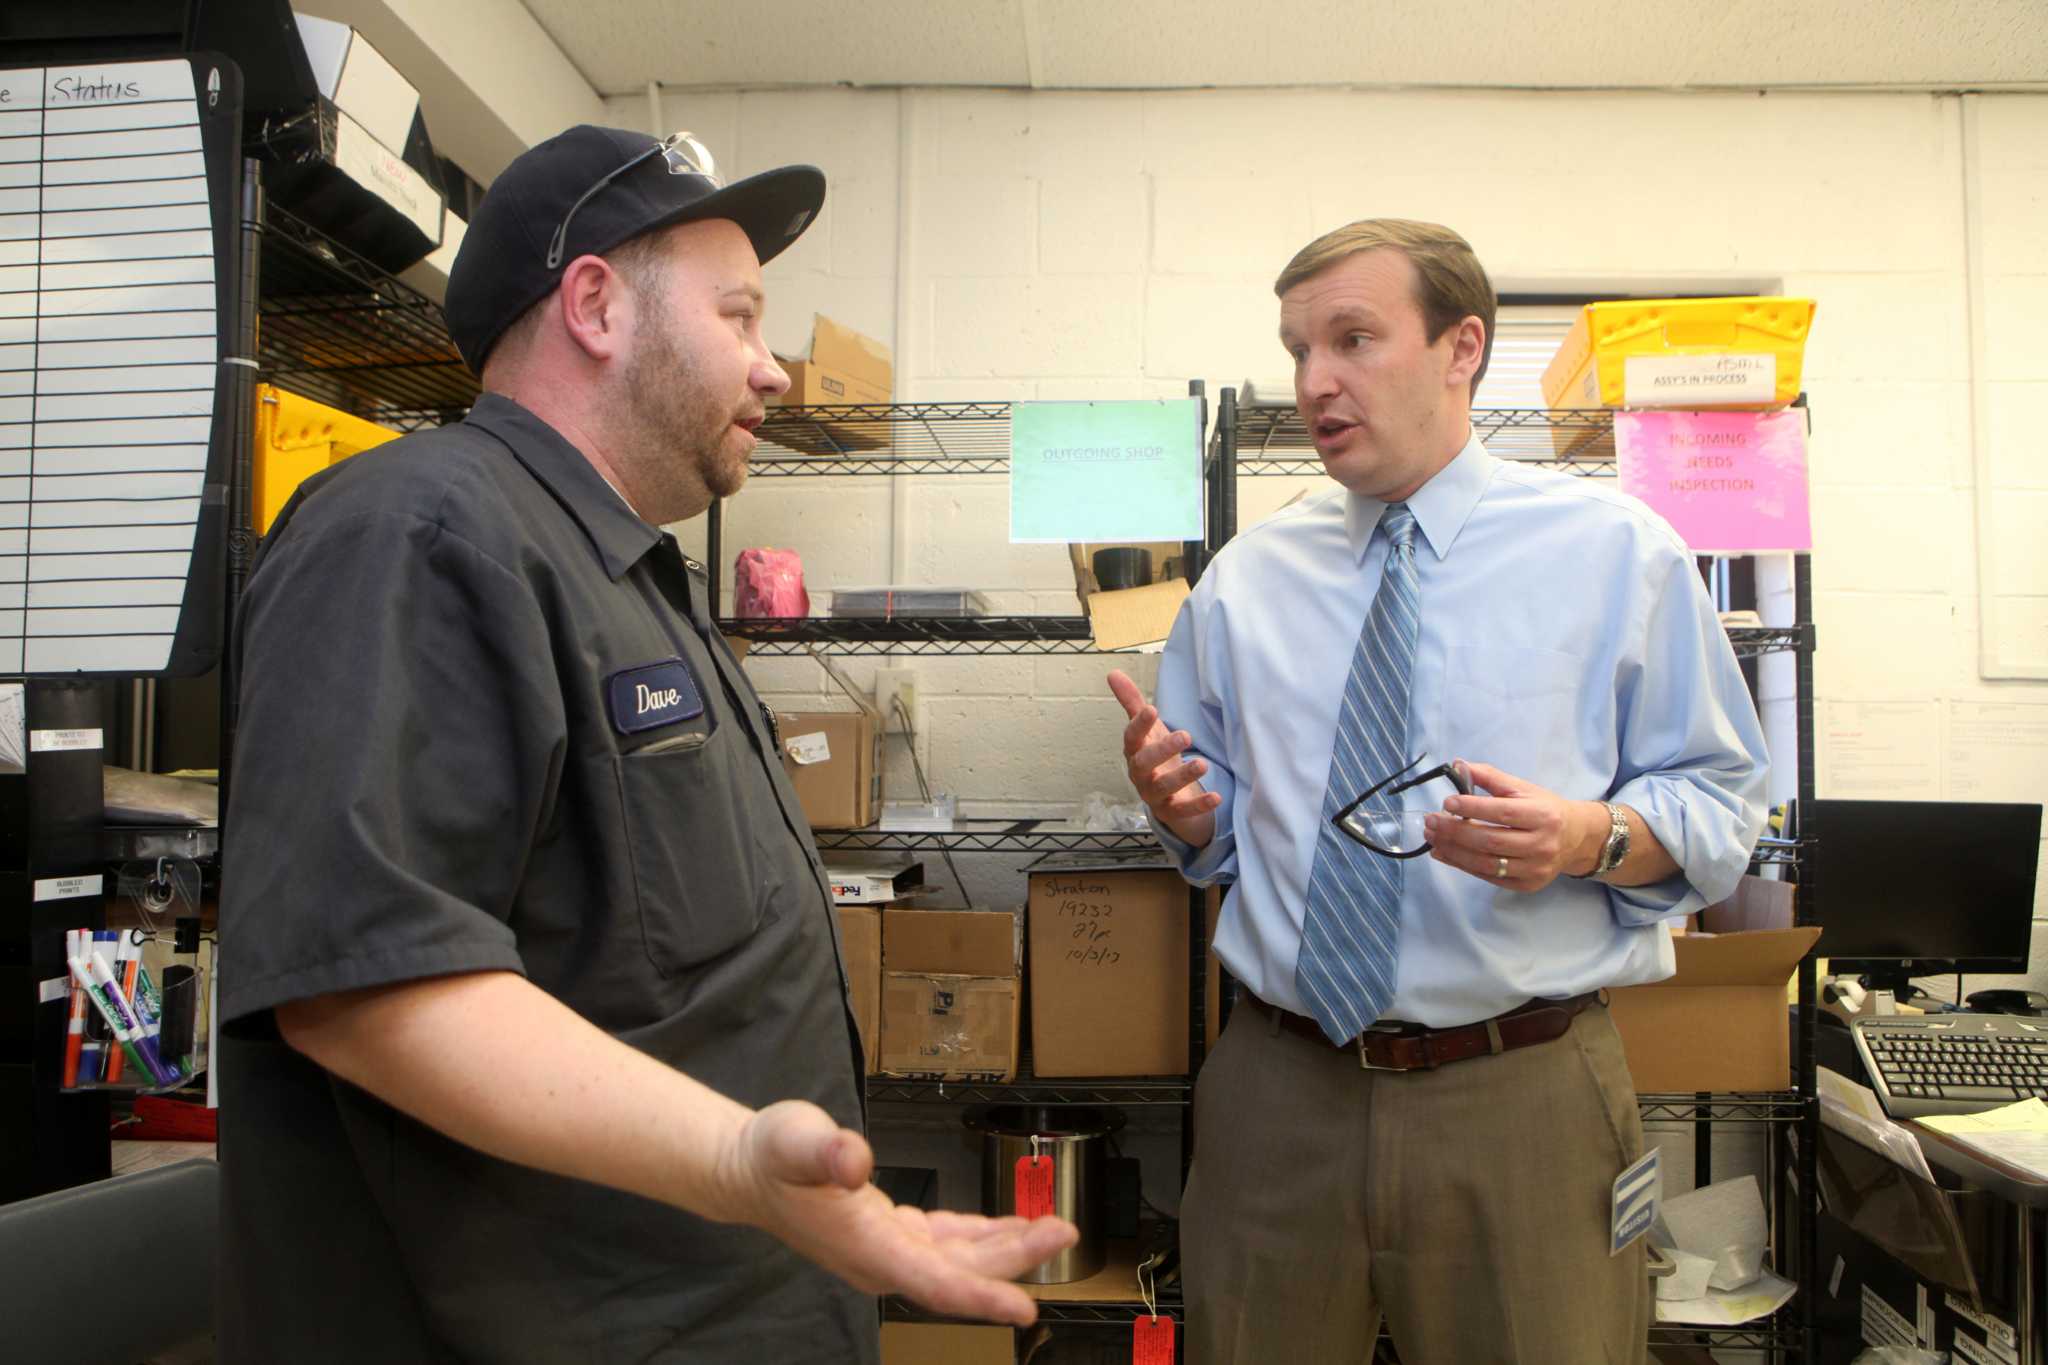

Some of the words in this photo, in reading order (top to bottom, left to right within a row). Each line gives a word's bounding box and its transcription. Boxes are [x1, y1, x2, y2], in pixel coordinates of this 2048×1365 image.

[53, 75, 141, 101] Status
[1689, 374, 1701, 385] IN
[1703, 372, 1748, 385] PROCESS
[1670, 432, 1747, 446] INCOMING
[1042, 447, 1121, 461] OUTGOING
[1127, 445, 1164, 459] SHOP
[1687, 455, 1734, 469] NEEDS
[1669, 479, 1755, 492] INSPECTION
[635, 683, 682, 715] Dave
[1058, 899, 1113, 918] 19232
